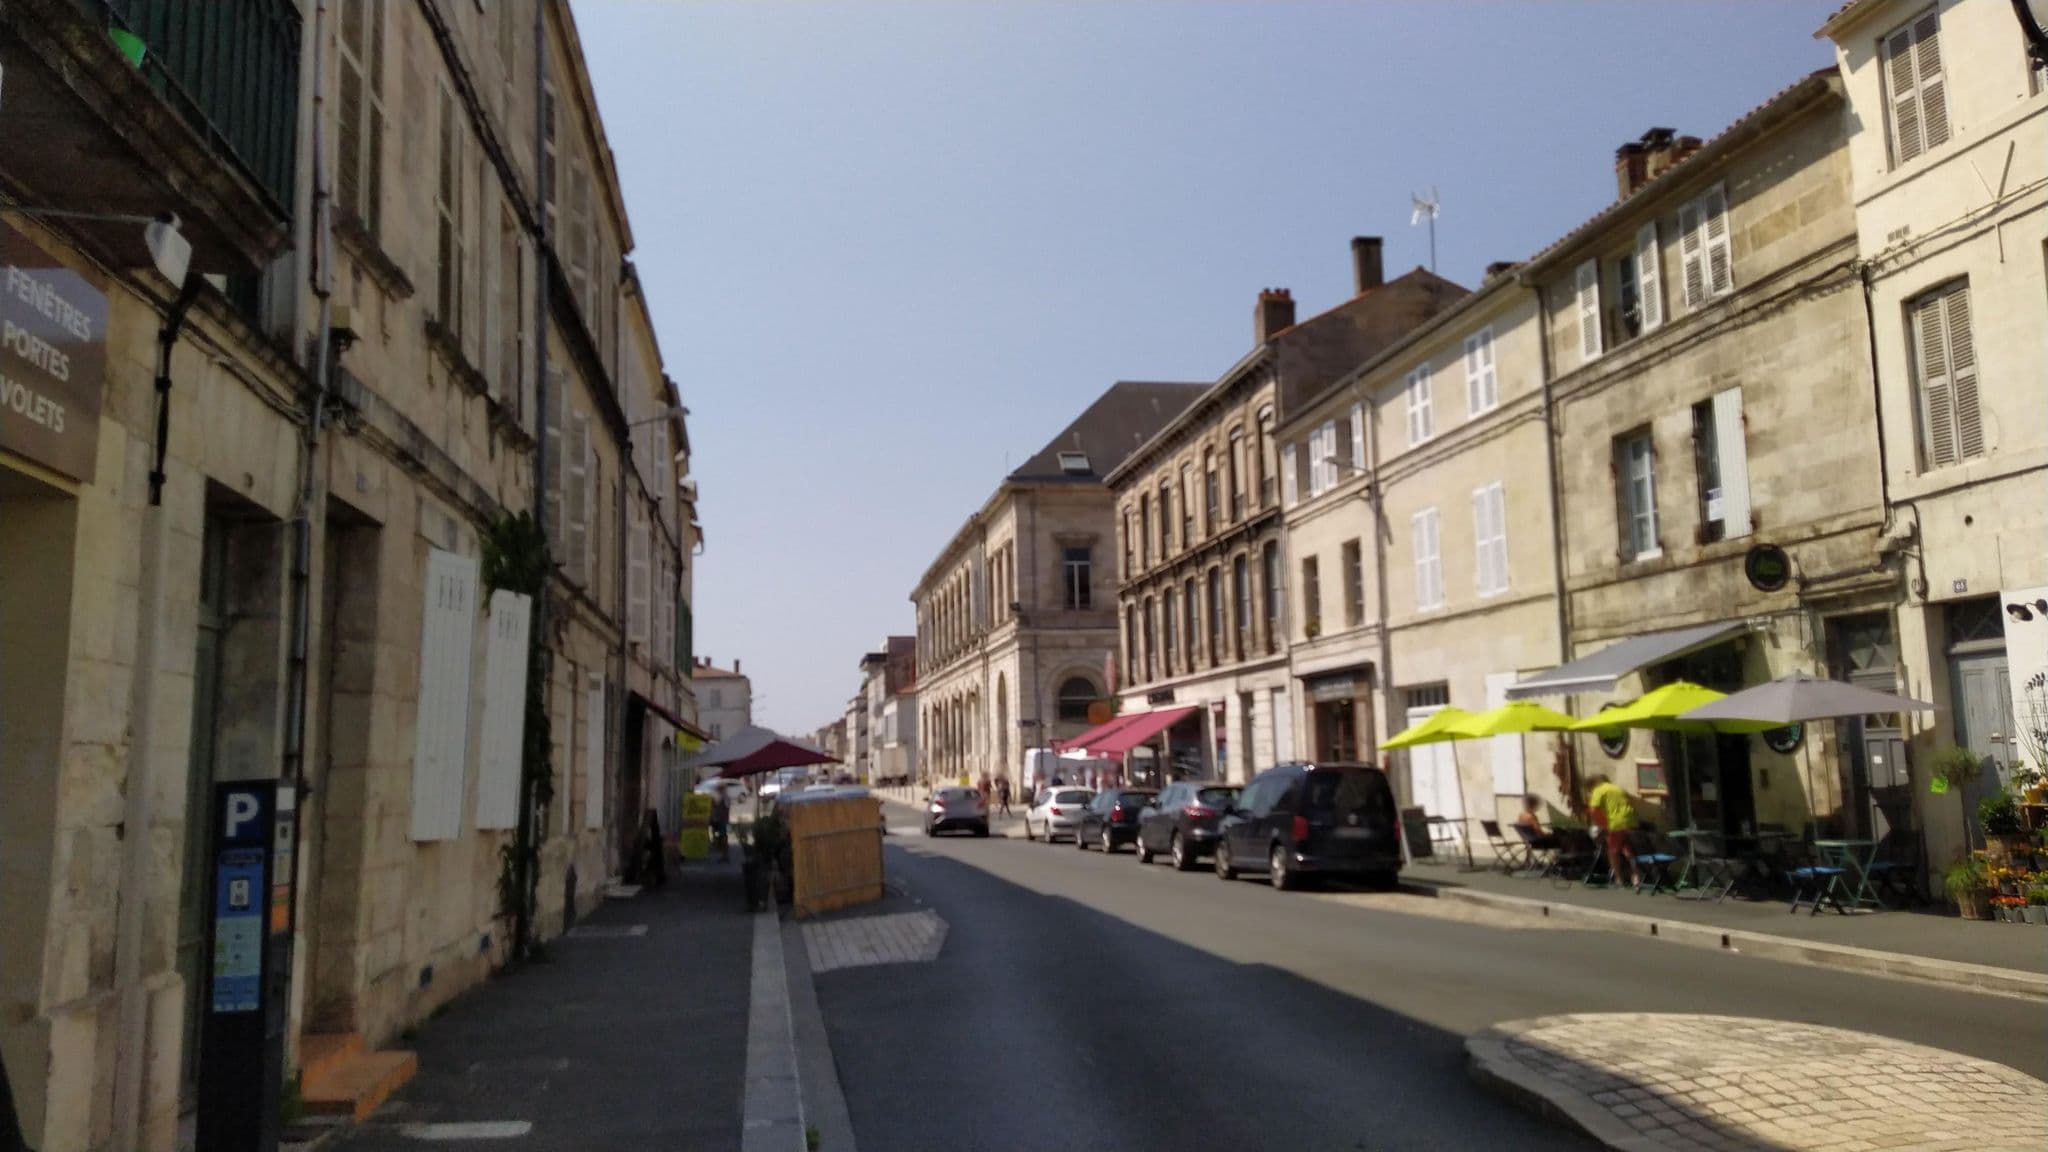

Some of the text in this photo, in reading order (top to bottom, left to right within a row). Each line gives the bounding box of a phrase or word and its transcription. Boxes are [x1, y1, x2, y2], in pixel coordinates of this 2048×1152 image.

[7, 264, 92, 343] FENÊTRES
[2, 319, 70, 382] PORTES
[0, 373, 65, 433] VOLETS
[226, 792, 259, 838] P
